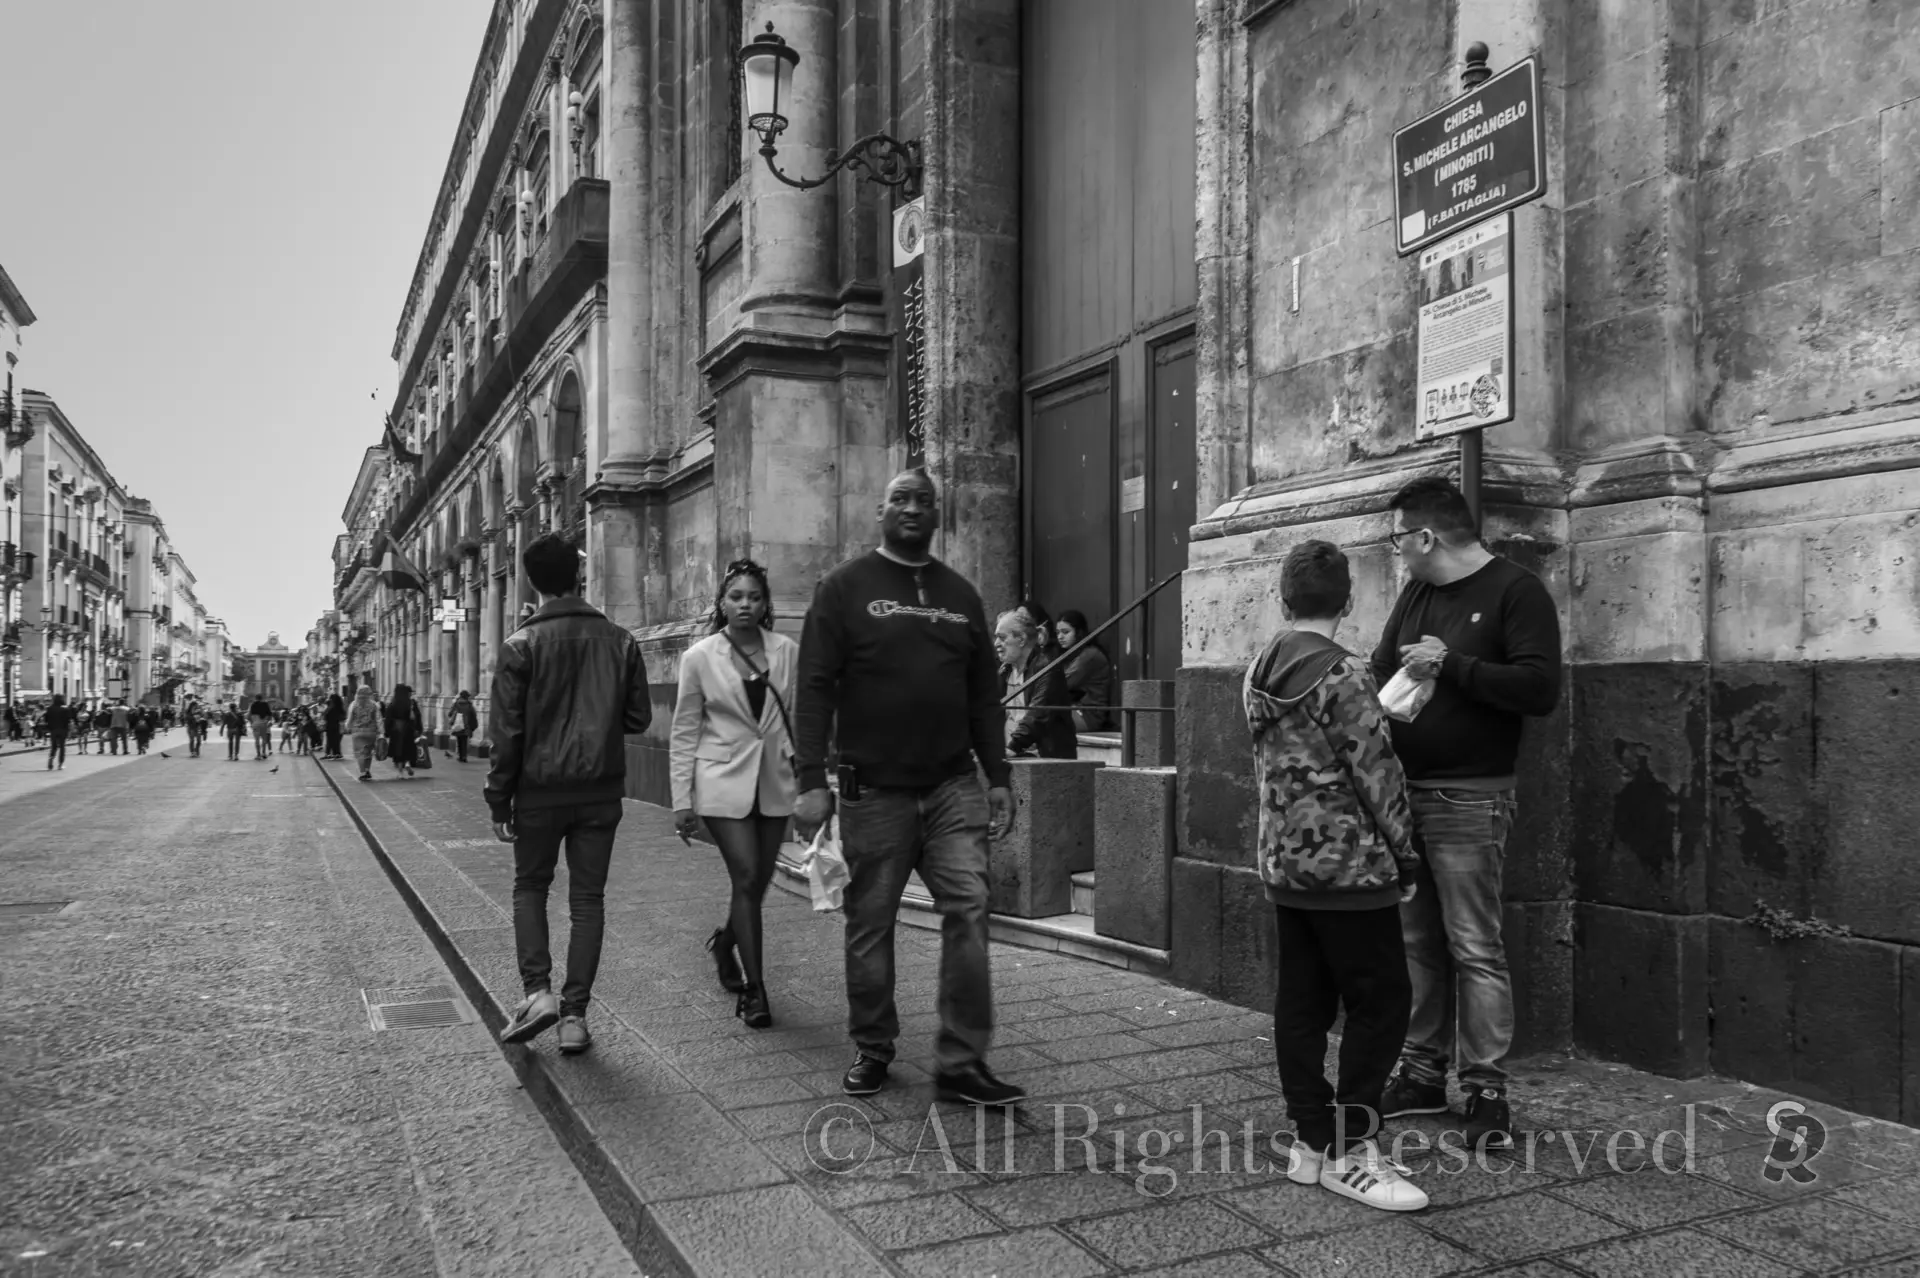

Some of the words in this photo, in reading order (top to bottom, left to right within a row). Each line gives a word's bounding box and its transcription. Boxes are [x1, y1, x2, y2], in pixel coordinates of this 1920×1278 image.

[1414, 136, 1458, 172] MICHELE
[1459, 100, 1527, 148] ARCANGELO
[1444, 100, 1484, 133] CHIESA
[1434, 142, 1495, 187] (MINORITI)
